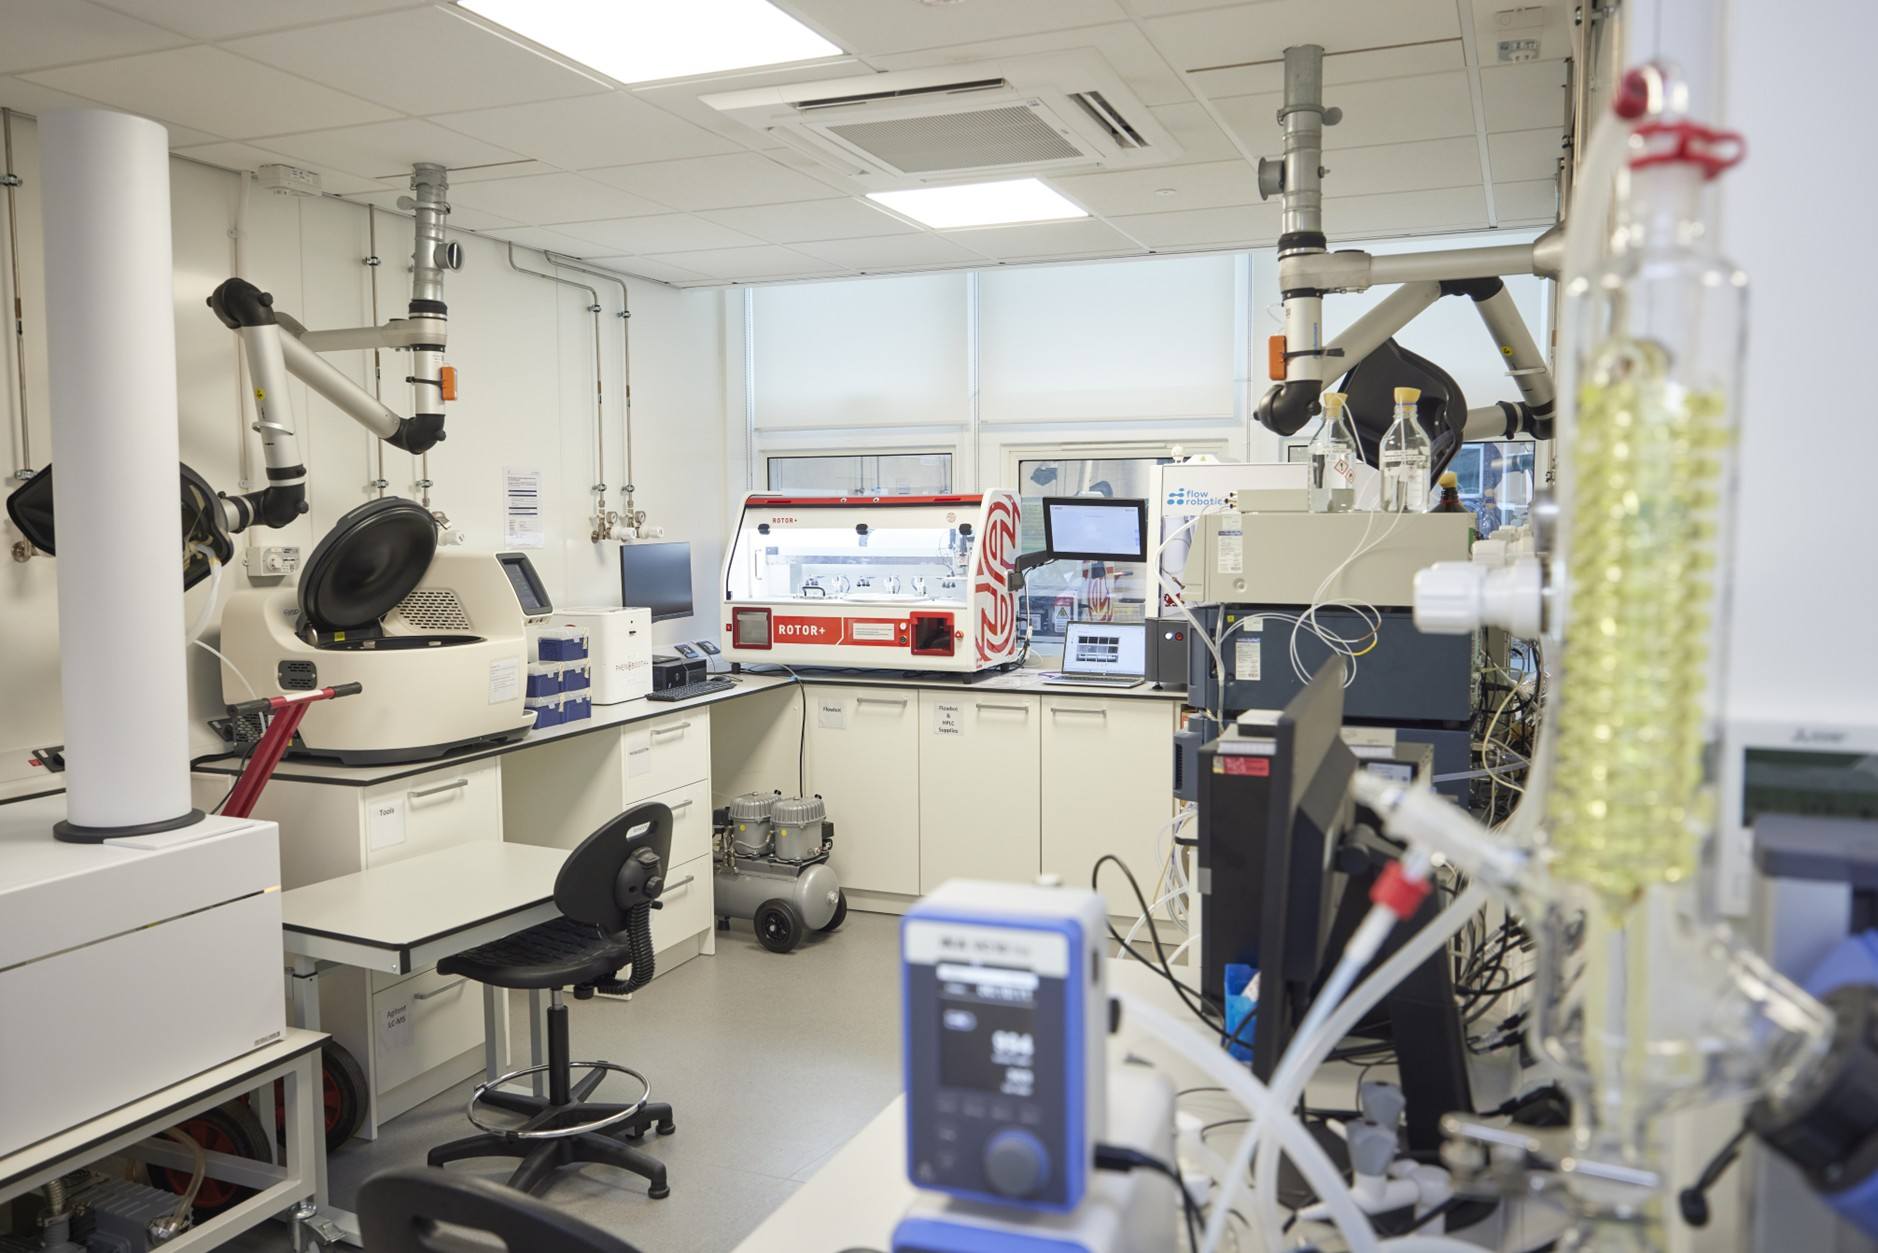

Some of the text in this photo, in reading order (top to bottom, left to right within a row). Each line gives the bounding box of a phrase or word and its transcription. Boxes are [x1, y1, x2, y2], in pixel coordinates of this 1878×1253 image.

[1186, 489, 1208, 498] flow
[1186, 497, 1228, 505] robotic
[772, 516, 798, 524] ROTOR+
[778, 624, 826, 636] ROTOR+
